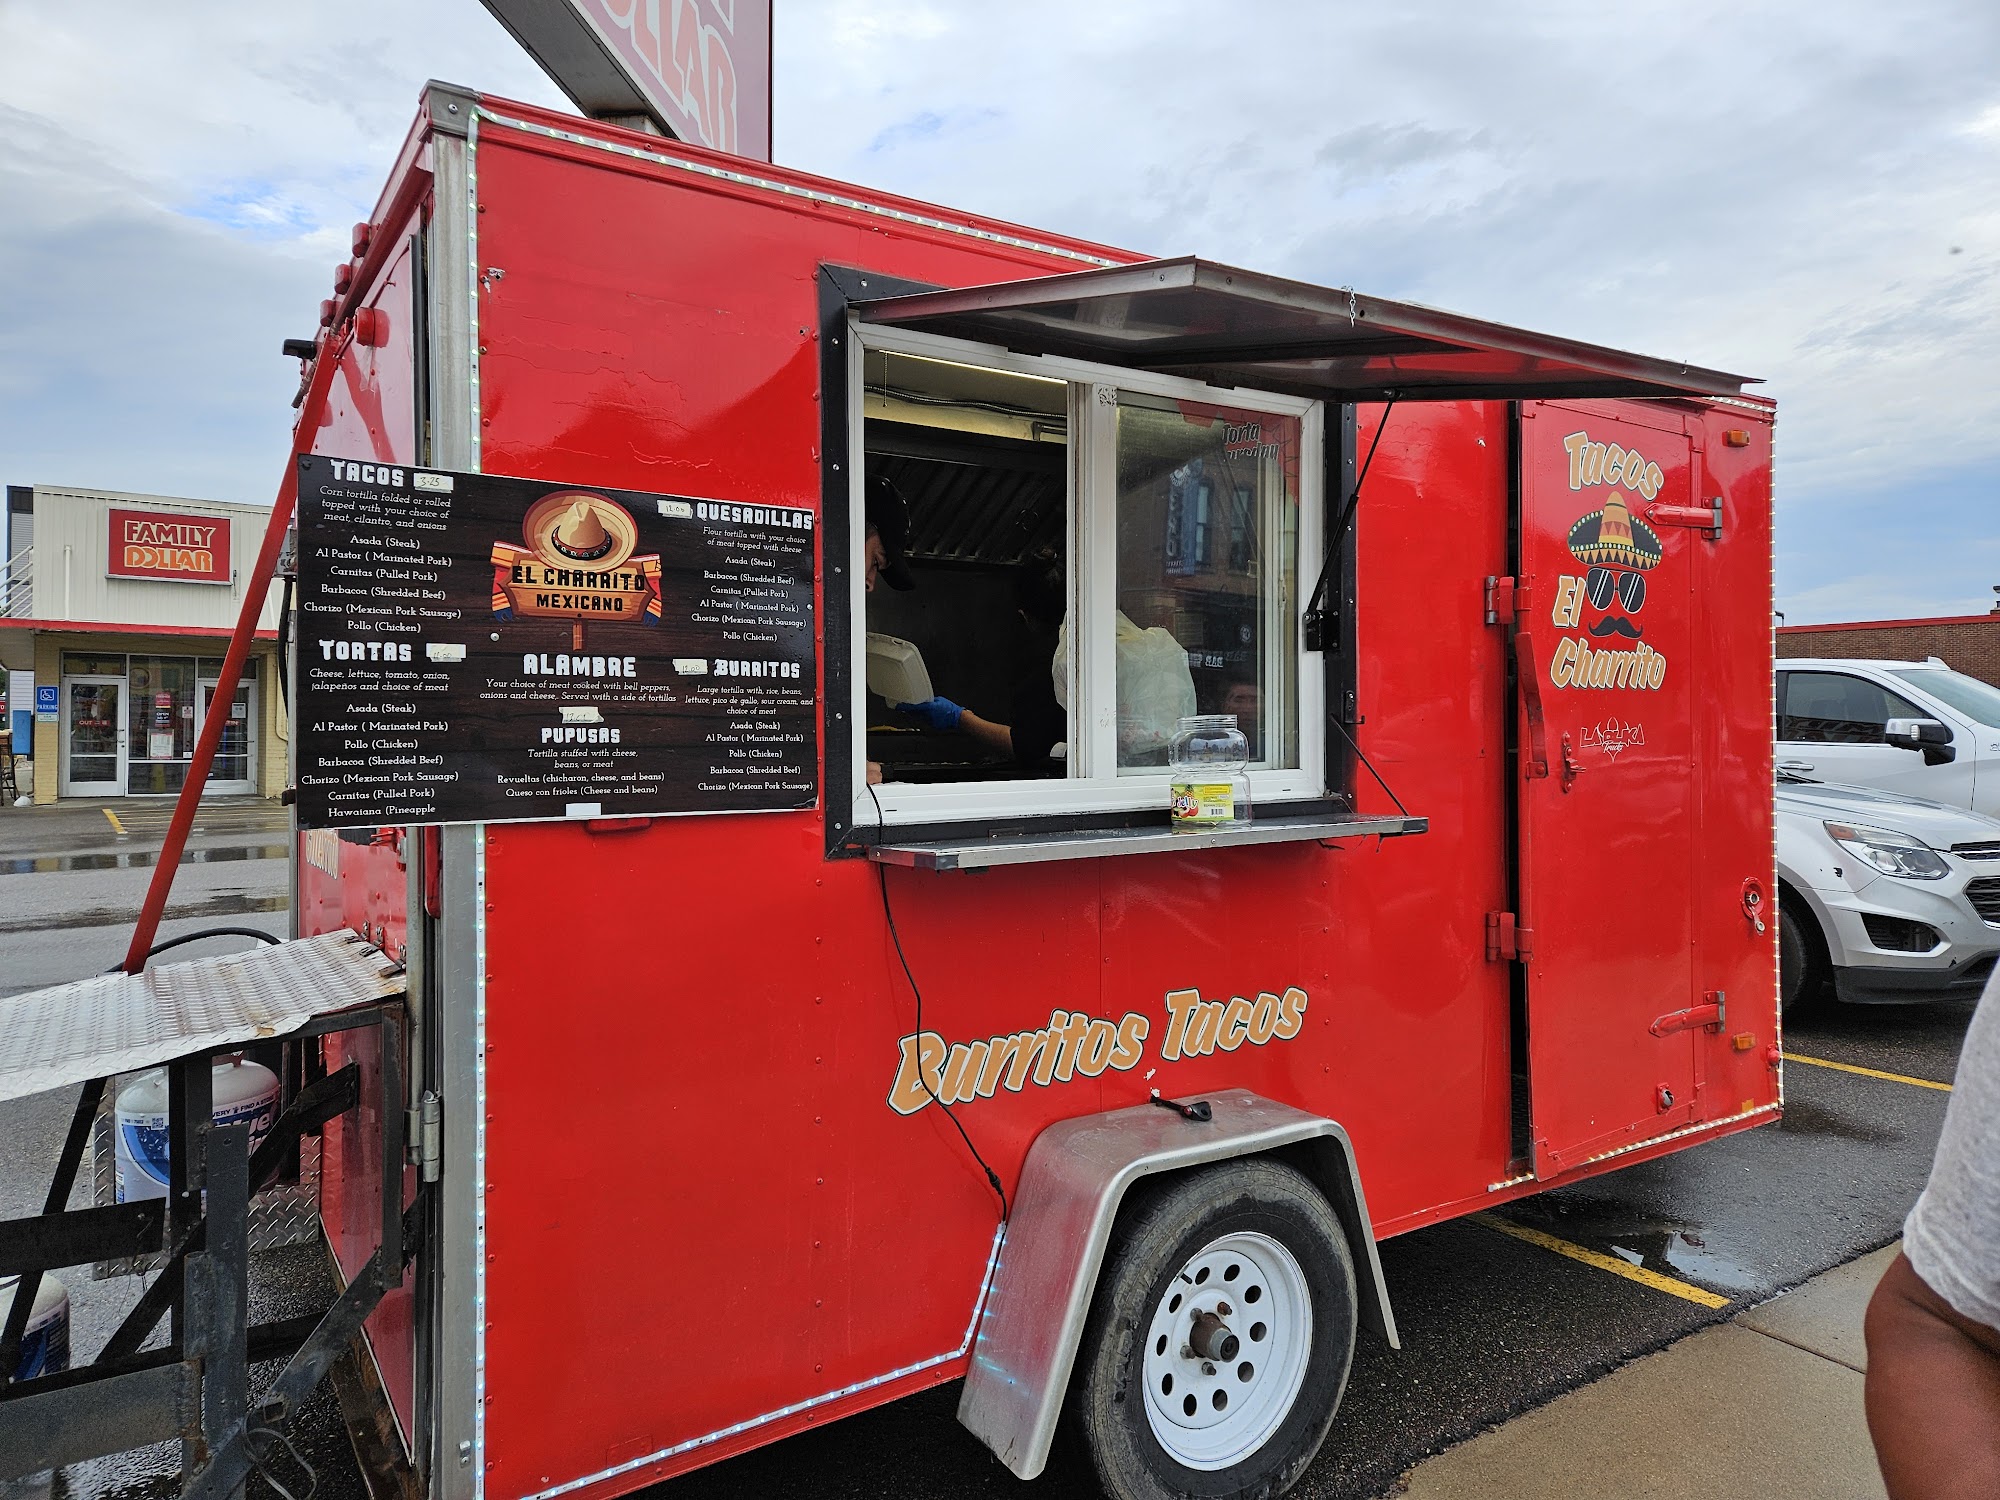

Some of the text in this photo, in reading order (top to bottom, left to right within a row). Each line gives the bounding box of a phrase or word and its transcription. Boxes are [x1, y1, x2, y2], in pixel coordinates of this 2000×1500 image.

[330, 459, 404, 487] TACOS
[1564, 430, 1664, 501] Tacos
[319, 485, 343, 496] Corn
[346, 489, 377, 500] tortilla
[381, 492, 410, 503] folded
[425, 497, 451, 507] rolled
[322, 498, 449, 518] topped with your choice of
[697, 502, 813, 530] QUESADILLAS
[324, 513, 446, 530] meat, cilantro, and onions
[124, 520, 216, 548] FAMILY
[350, 535, 420, 549] Asada (Steak)
[702, 526, 722, 535] Flour
[724, 529, 747, 538] tortilla
[749, 531, 766, 540] with
[785, 534, 806, 543] choice
[707, 537, 714, 545] of
[736, 541, 761, 550] topped
[763, 543, 778, 551] with
[780, 544, 802, 553] cheese
[124, 545, 213, 573] DOLLAR
[315, 547, 452, 567] Al Pastor Marinated Pork)
[330, 565, 437, 582] Carnitas (Pulled Pork)
[512, 565, 645, 591] EL CHARRITO
[321, 583, 446, 600] Barbacoa (Shredded Beef)
[536, 593, 623, 612] MEXICANO
[1552, 575, 1586, 628] El
[304, 601, 461, 619] Chorizo (Mexican Pork Sausage)
[347, 620, 421, 632] Pollo (Chicken)
[319, 639, 412, 662] TORTAS
[523, 653, 637, 677] ALAMBRE
[714, 659, 800, 678] BURRITOS
[1551, 637, 1667, 691] Charrito
[309, 668, 344, 678] Cheese,
[348, 668, 381, 678] lettuce,
[385, 670, 419, 679] tomato,
[311, 681, 356, 692] jalapeños
[359, 681, 378, 690] and
[381, 681, 410, 690] choice
[413, 681, 422, 690] of
[487, 678, 507, 687] Your
[510, 678, 535, 688] choice
[538, 679, 546, 688] of
[572, 680, 600, 689] cooked
[603, 681, 621, 690] with
[623, 681, 638, 690] bell
[697, 684, 718, 695] Large
[721, 685, 744, 693] tortilla
[781, 686, 802, 695] beans,
[561, 691, 589, 699] Served
[592, 692, 610, 700] with
[621, 692, 636, 700] side
[638, 691, 646, 701] of
[648, 693, 676, 701] tortillas
[685, 694, 710, 704] lettuce,
[729, 695, 738, 704] de
[740, 696, 758, 706] gallo,
[800, 697, 813, 705] and
[346, 703, 416, 713] Asada (Steak)
[726, 706, 748, 714] choice
[749, 706, 757, 714] of
[312, 721, 448, 731] Al Pastor Marinated Pork)
[541, 727, 621, 743] PUPUSAS
[344, 738, 418, 749] Pollo (Chicken)
[318, 754, 443, 766] Barbacoa (Shredded Beef)
[527, 748, 638, 757] Tortilla stuffed with cheese,
[554, 759, 579, 768] beans,
[301, 771, 458, 784] Chorizo (Mexican Pork Sausage)
[497, 772, 664, 783] Revueltas (chicharon, cheese, and beans)
[328, 787, 435, 800] Carnitas (Pulled Pork)
[505, 788, 533, 796] Queso
[552, 786, 577, 795] frioles
[580, 786, 611, 795] (Cheese
[613, 785, 629, 793] and
[631, 784, 658, 793] beans)
[328, 804, 435, 816] Hawaiana (Pineapple
[886, 987, 1308, 1115] Burritos Tacos
